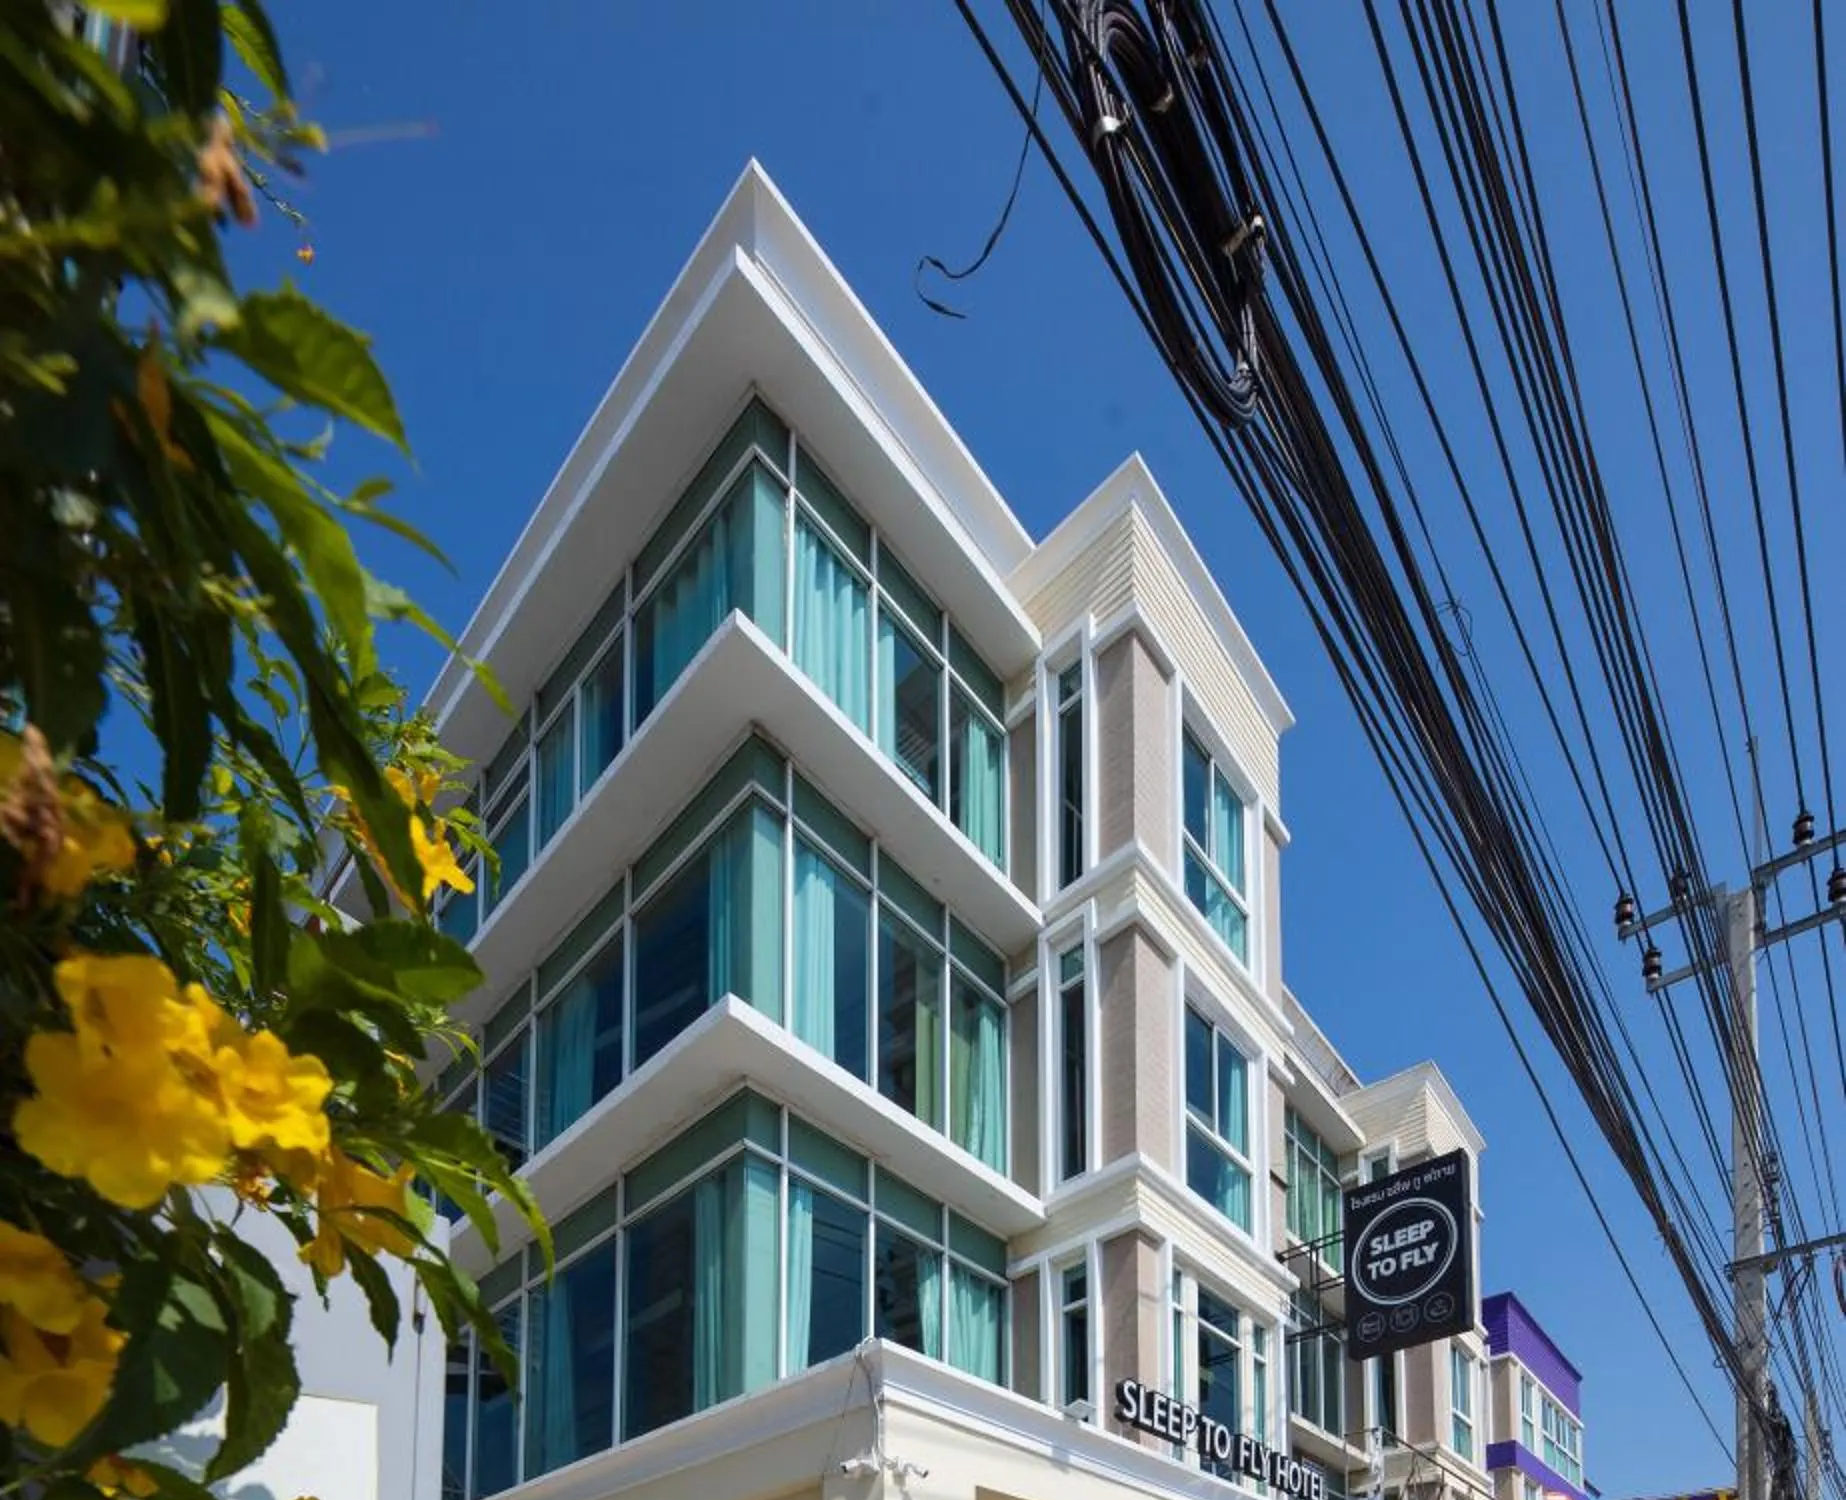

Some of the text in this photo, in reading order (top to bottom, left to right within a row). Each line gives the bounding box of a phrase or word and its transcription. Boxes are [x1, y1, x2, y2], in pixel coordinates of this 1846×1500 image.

[1369, 1219, 1435, 1256] SLEEP
[1367, 1241, 1439, 1281] TO FLY
[1119, 1378, 1198, 1441] SLEEP
[1200, 1415, 1231, 1459] TO
[1239, 1435, 1272, 1480] FLY
